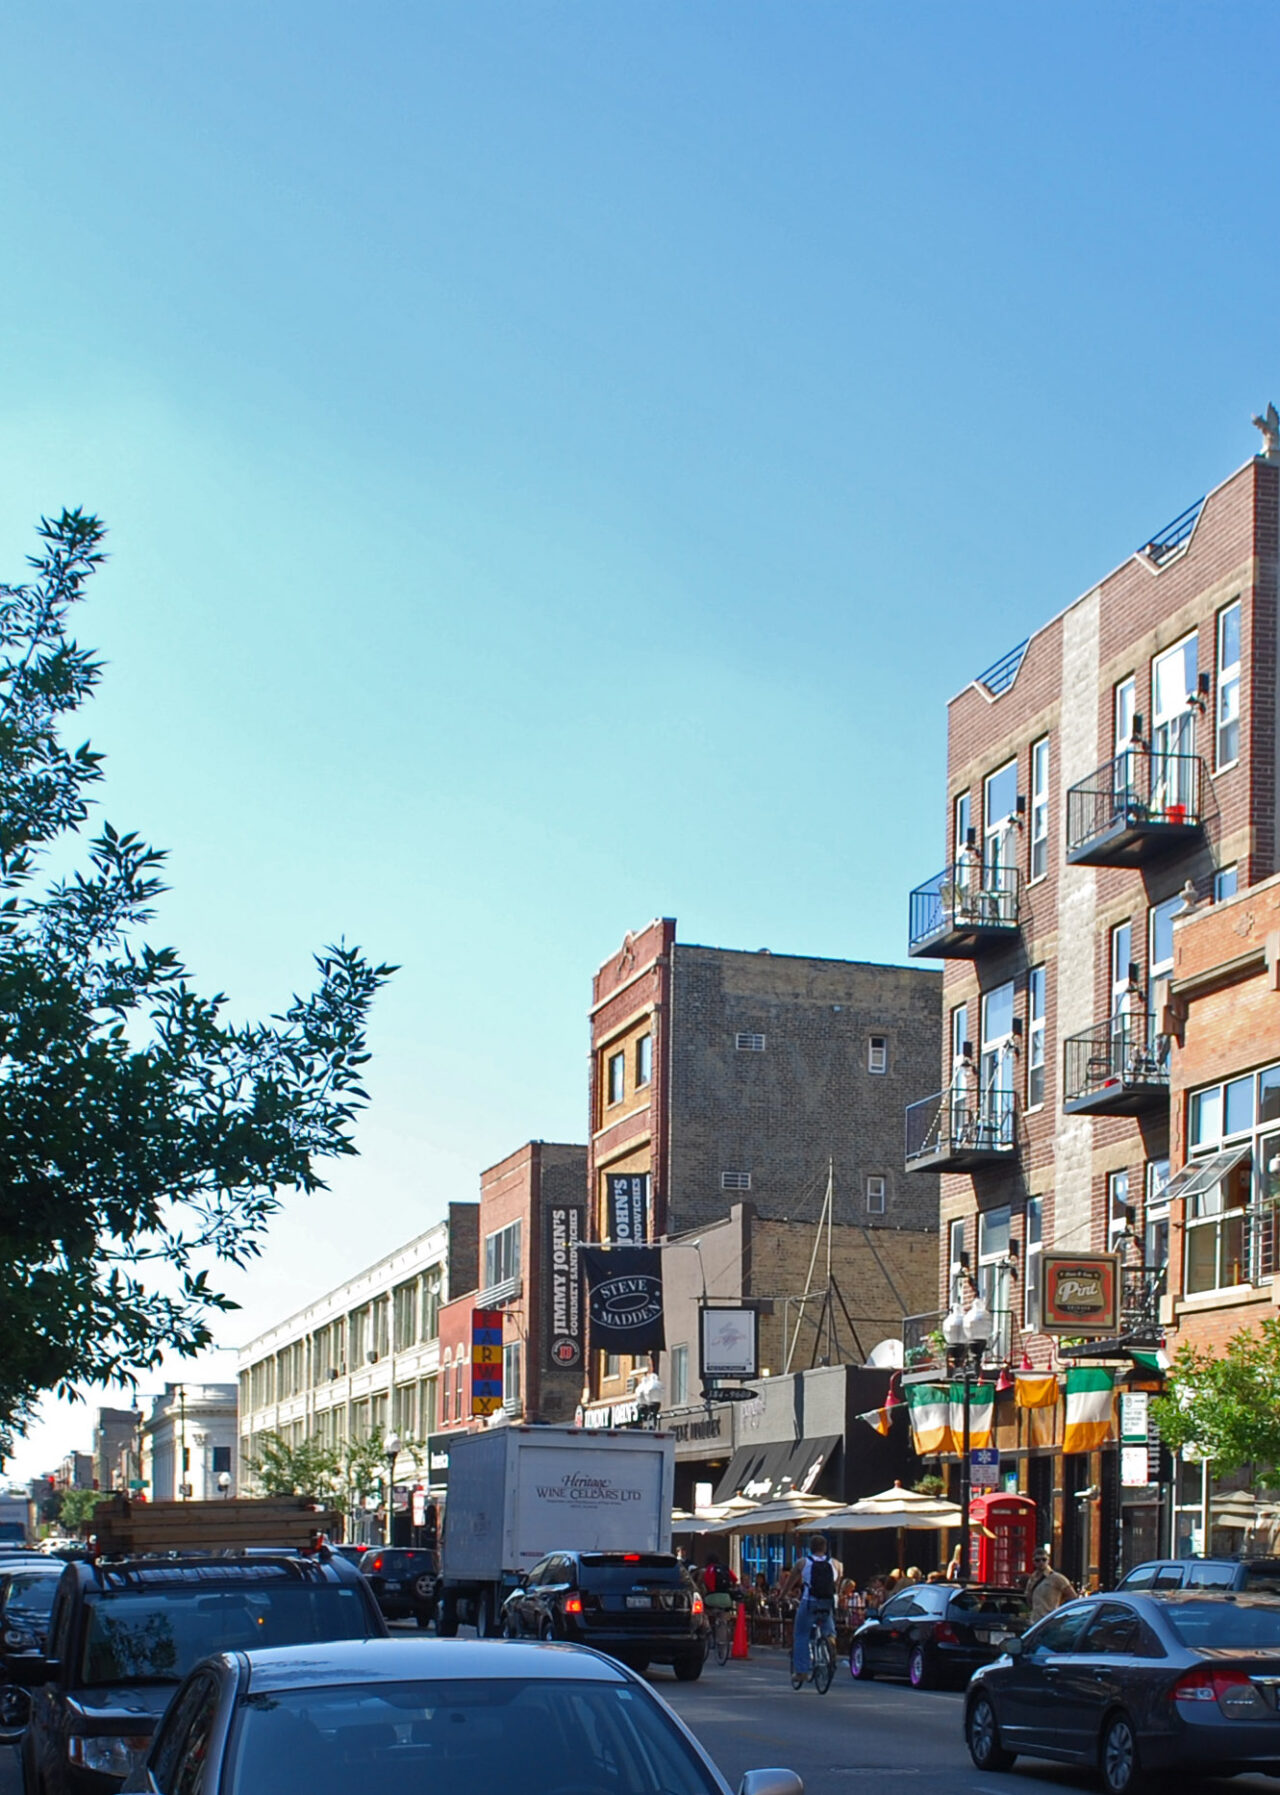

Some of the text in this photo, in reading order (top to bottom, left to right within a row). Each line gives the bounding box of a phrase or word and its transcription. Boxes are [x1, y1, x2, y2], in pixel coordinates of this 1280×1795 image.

[552, 1209, 569, 1271] JOHN'S
[568, 1208, 579, 1336] GOURMET SANDWICHES
[600, 1279, 648, 1299] STEVE
[1058, 1281, 1098, 1302] Pint
[553, 1273, 569, 1335] JIMMY
[601, 1300, 661, 1326] MADDEN
[477, 1311, 496, 1413] EARWAX
[561, 1471, 612, 1488] Heritage
[536, 1487, 642, 1502] WINE CELLARS LTD
